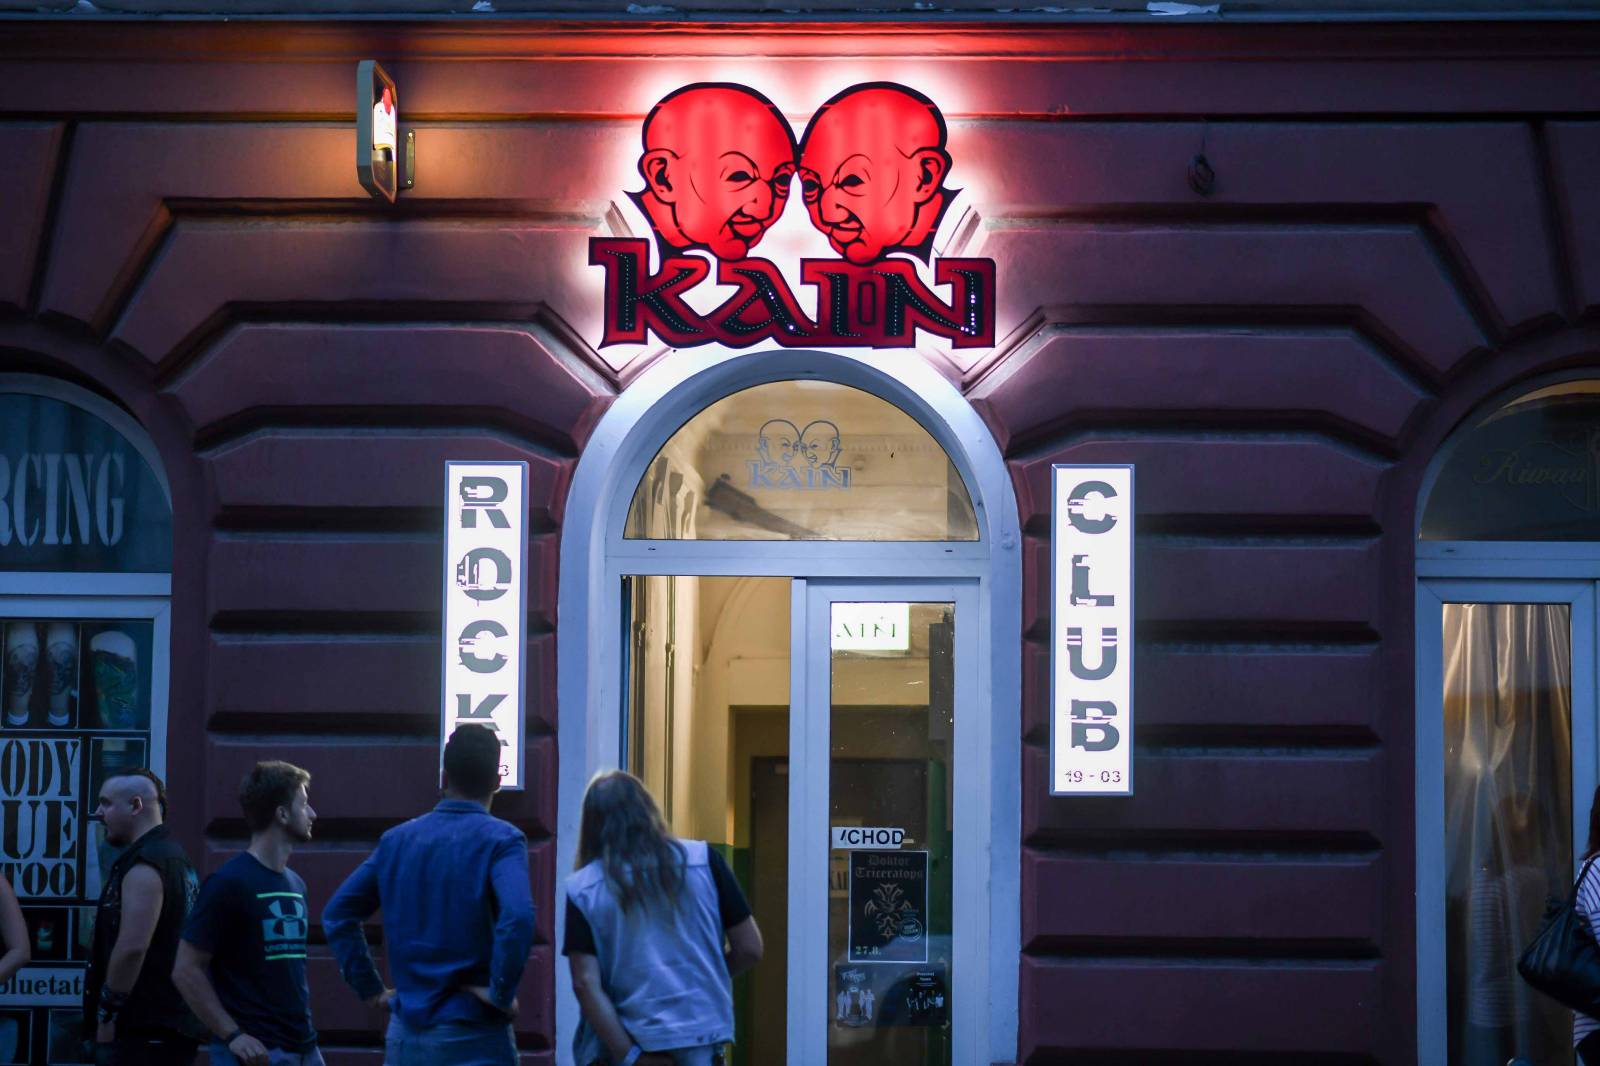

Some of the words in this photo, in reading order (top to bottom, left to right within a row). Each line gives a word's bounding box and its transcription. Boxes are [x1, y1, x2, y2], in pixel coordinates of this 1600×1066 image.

[588, 236, 996, 349] KAIN
[746, 460, 852, 490] KAIN
[455, 475, 512, 748] ROCK
[1067, 480, 1120, 752] CLUB
